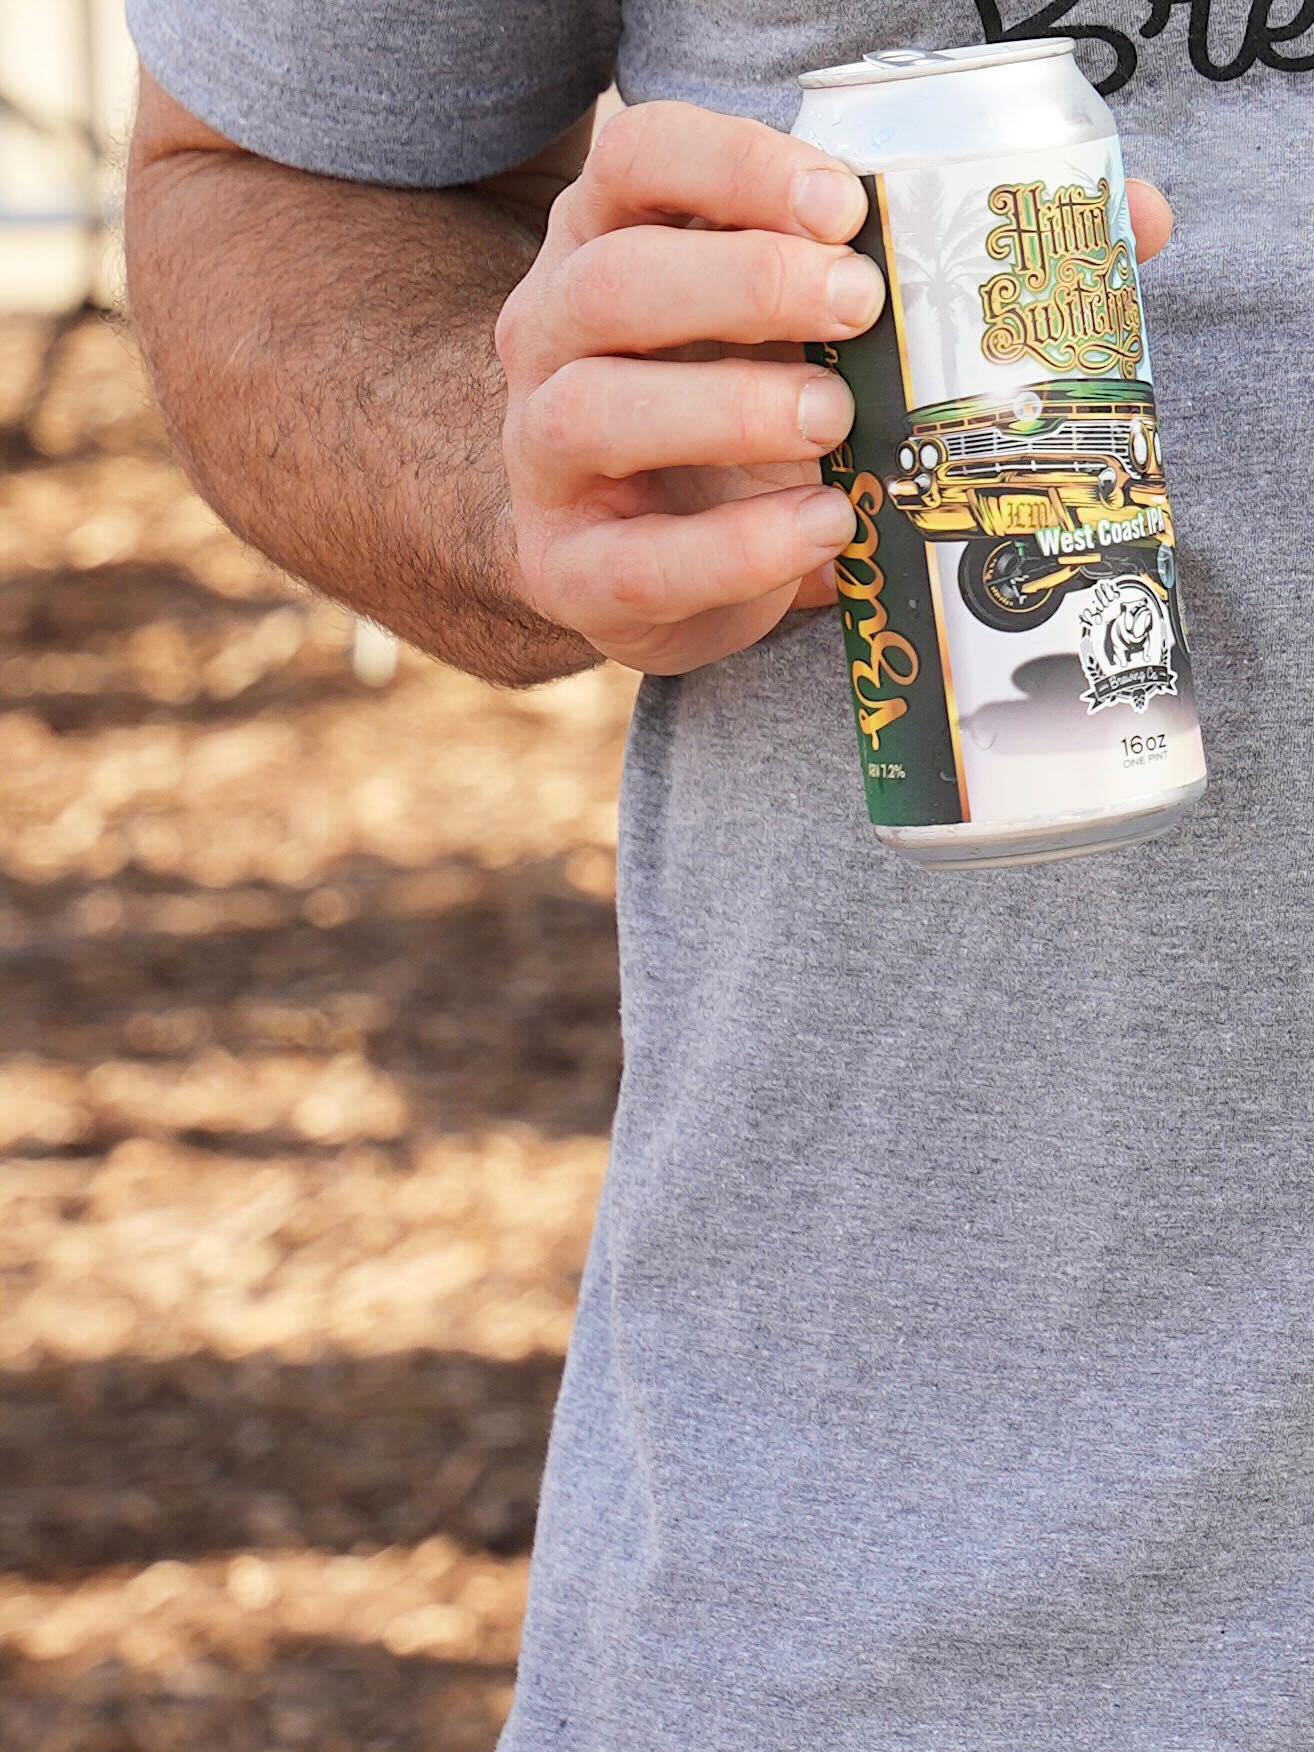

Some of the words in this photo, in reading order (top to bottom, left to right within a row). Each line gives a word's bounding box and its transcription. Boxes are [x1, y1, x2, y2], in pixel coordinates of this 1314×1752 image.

[1035, 524, 1095, 556] West
[1097, 511, 1147, 546] Coast
[1144, 506, 1165, 536] IPA
